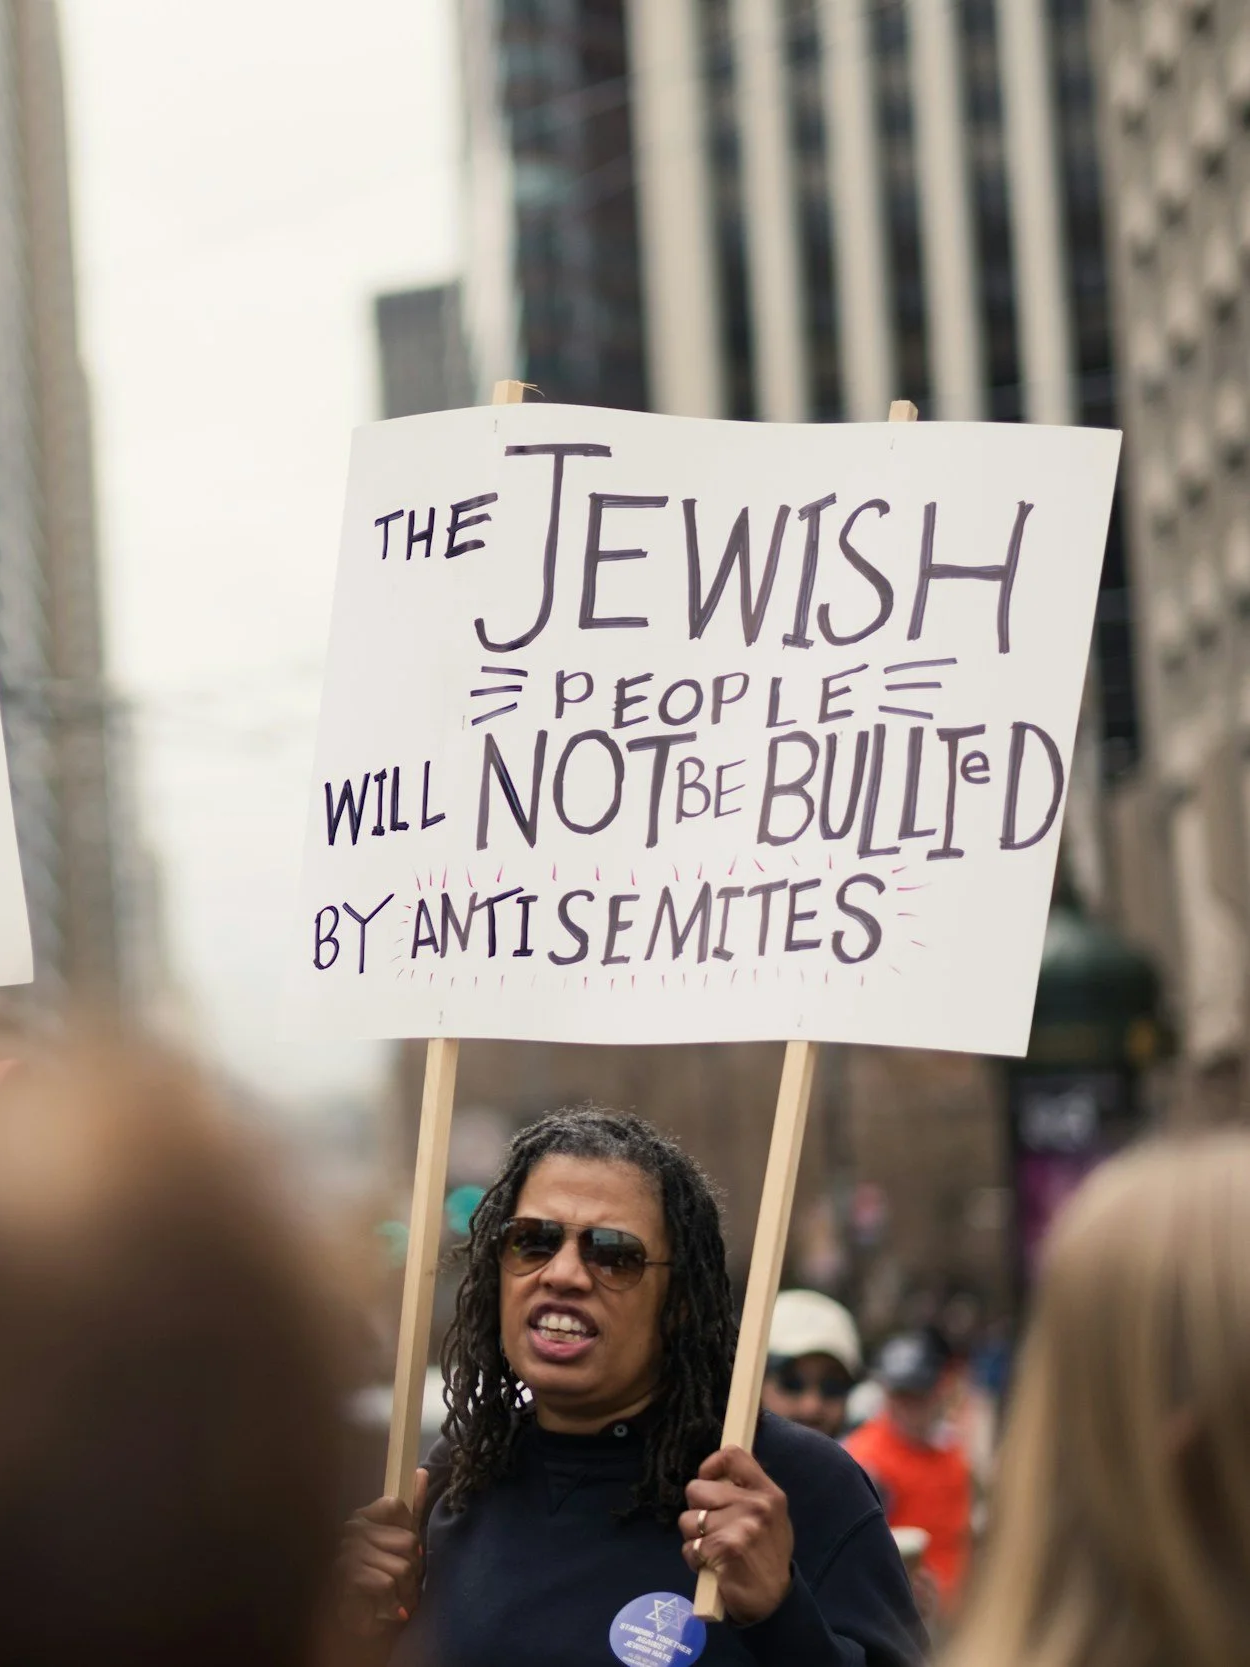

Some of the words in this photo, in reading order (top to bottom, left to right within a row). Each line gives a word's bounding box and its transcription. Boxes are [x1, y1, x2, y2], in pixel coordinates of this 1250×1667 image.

[374, 492, 499, 561] THE
[473, 443, 1035, 655] JEWISH
[554, 663, 870, 730] PEOPLE
[324, 760, 446, 847] WILL
[476, 729, 698, 851] NOT
[674, 756, 747, 825] BE
[312, 892, 395, 975] BY
[408, 873, 887, 967] ANTISEMITES
[651, 1648, 673, 1663] HATE
